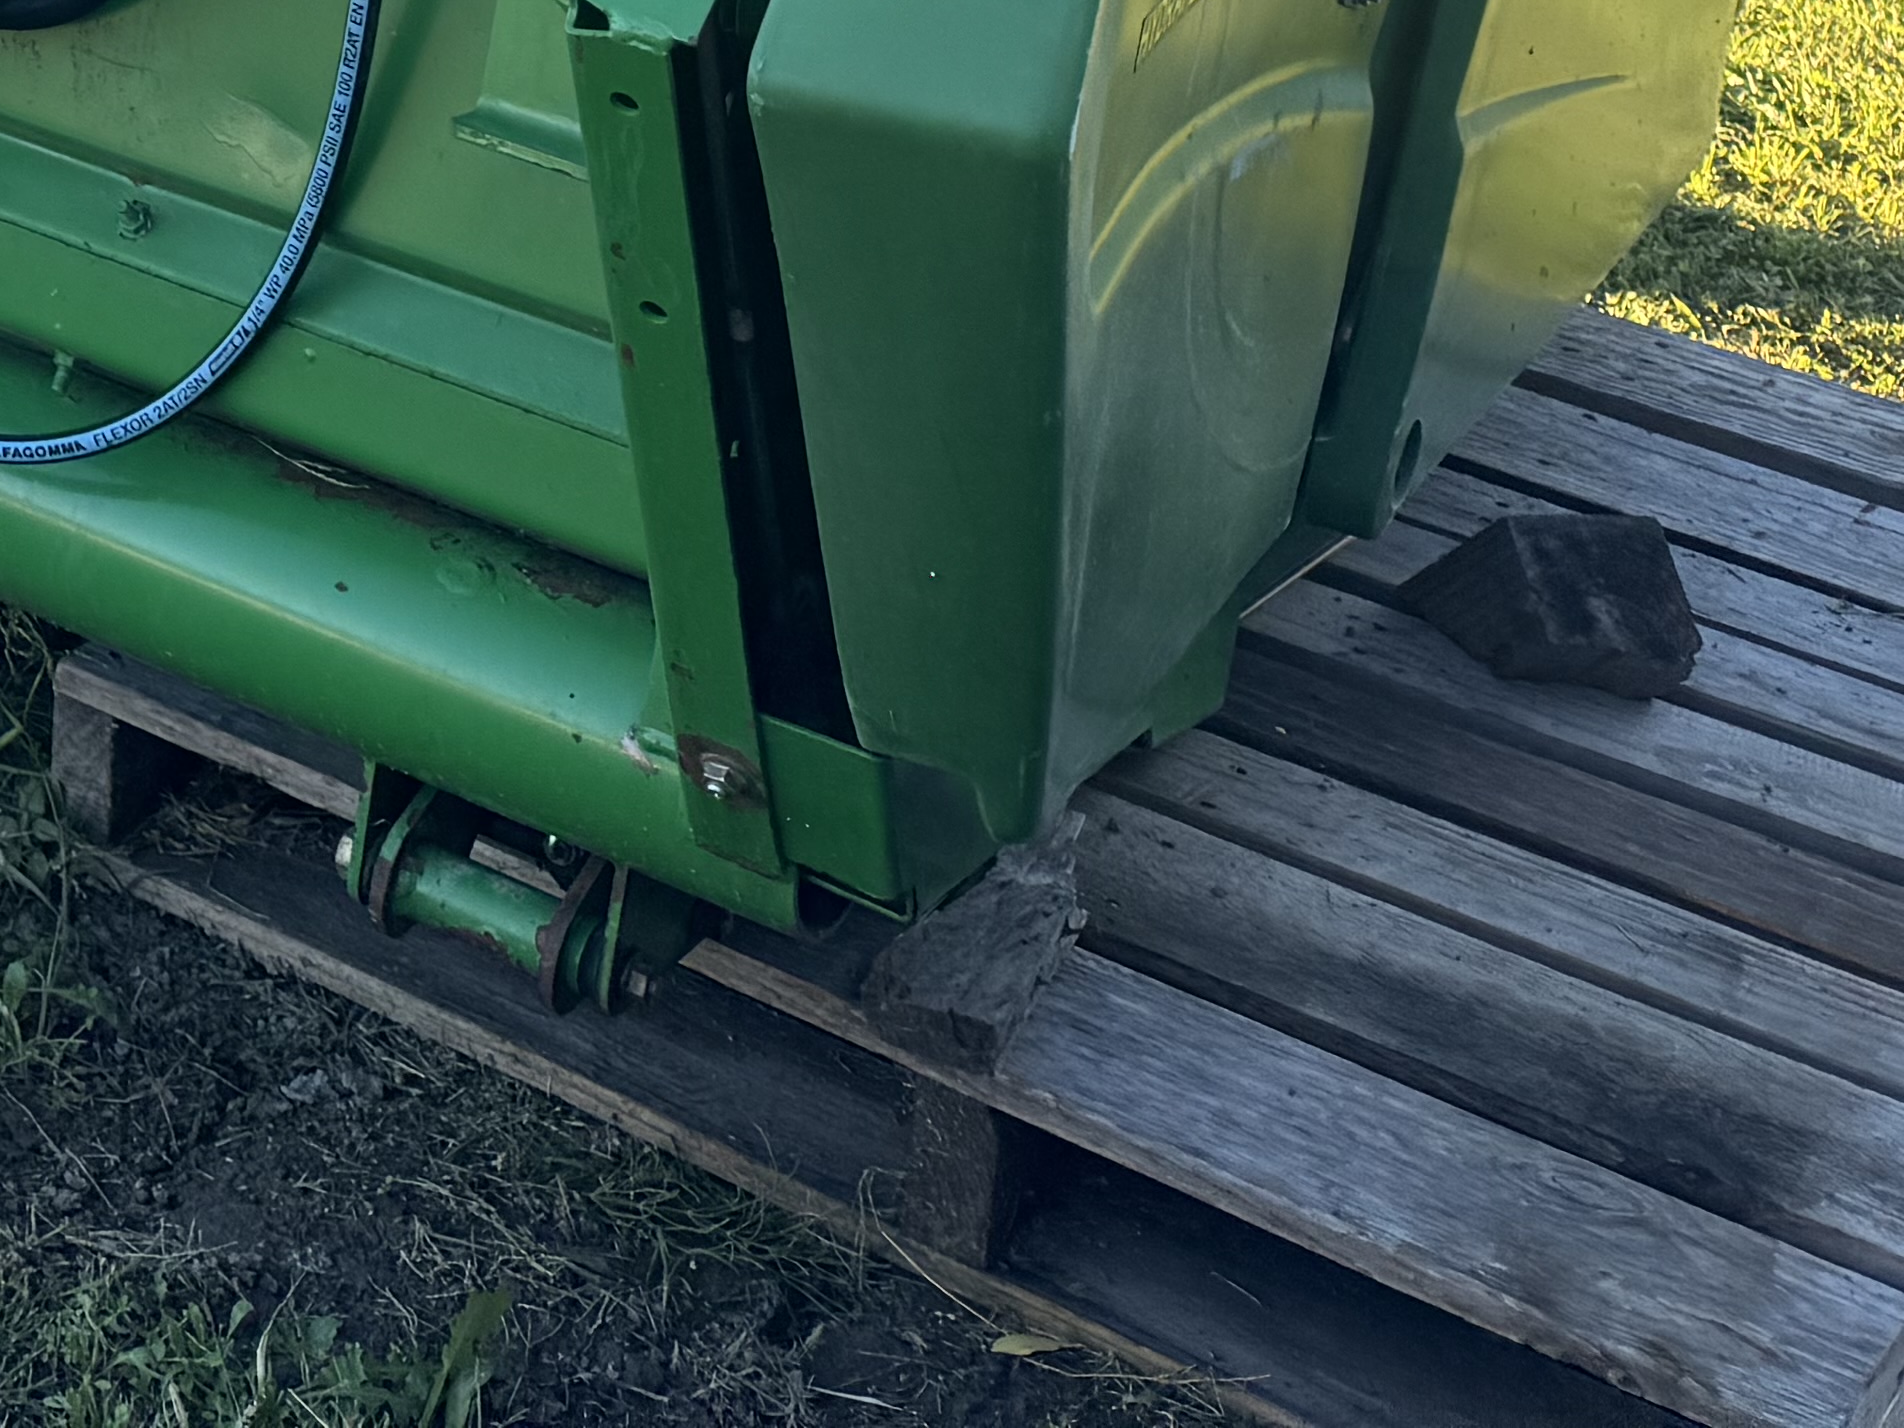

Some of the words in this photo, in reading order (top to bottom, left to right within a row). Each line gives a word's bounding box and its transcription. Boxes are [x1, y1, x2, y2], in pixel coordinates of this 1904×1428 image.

[349, 2, 364, 27] EN
[342, 31, 361, 71] R2AT
[337, 70, 354, 97] 100
[328, 102, 347, 134] SAE
[319, 134, 340, 168] PSI)
[305, 169, 329, 210] (5800
[292, 211, 315, 246] MPa
[280, 244, 300, 276] 40.0
[263, 273, 281, 300] WP
[153, 372, 209, 420] 2AT/2SN
[92, 411, 154, 448] FLEXOR
